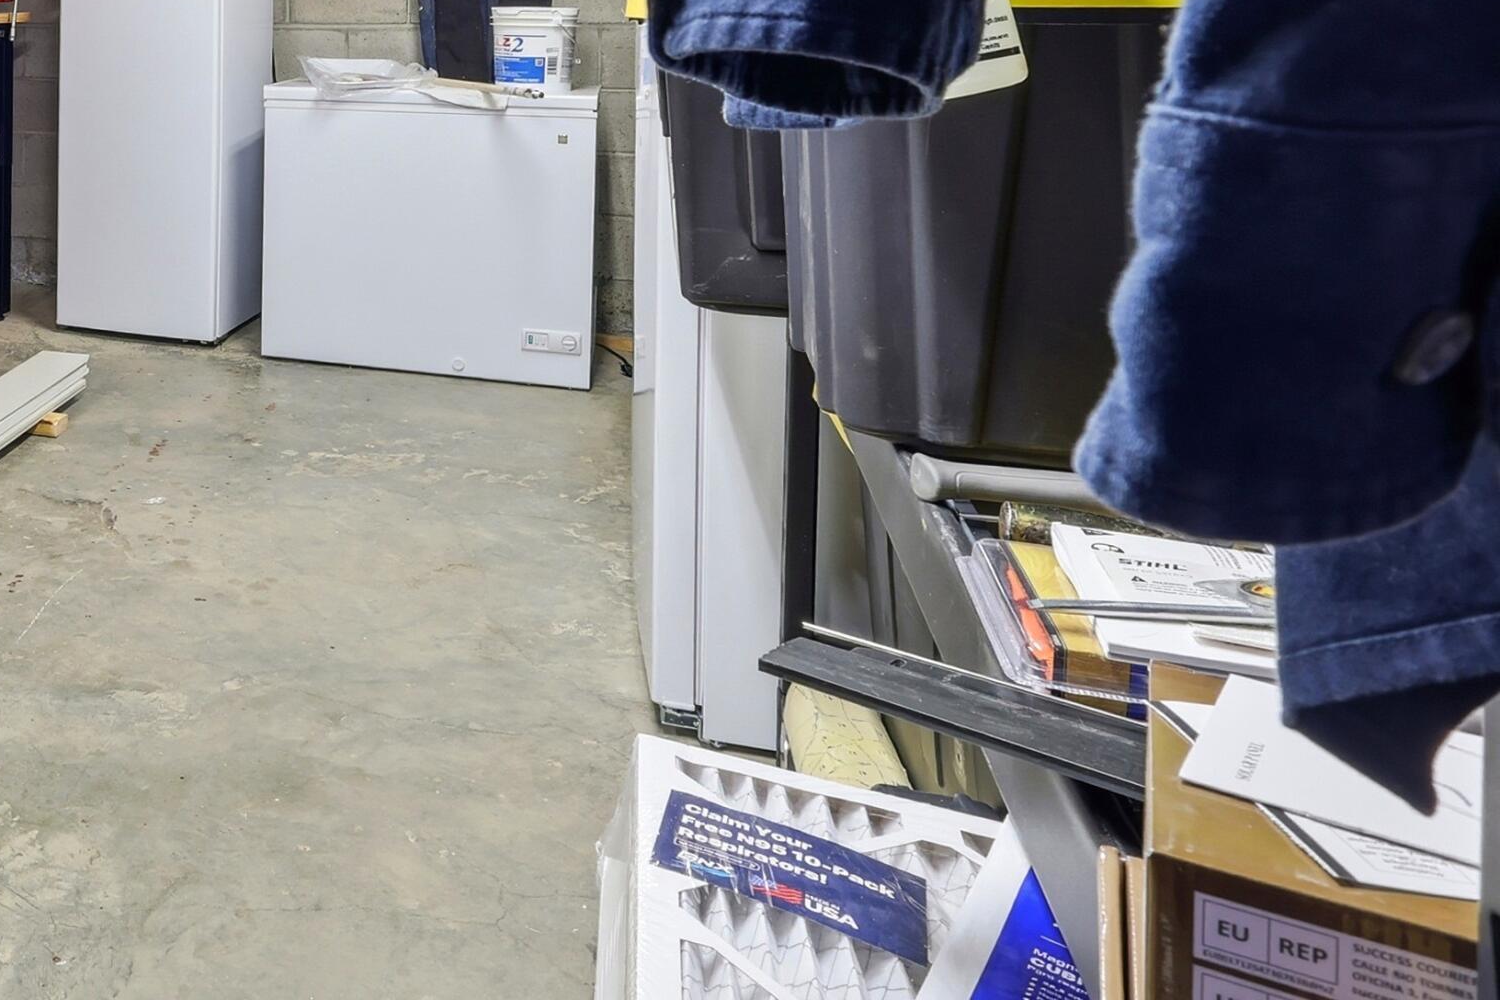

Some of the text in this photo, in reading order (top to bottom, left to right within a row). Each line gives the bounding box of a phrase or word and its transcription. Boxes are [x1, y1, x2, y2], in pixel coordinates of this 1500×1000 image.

[1118, 558, 1188, 571] STIHL
[684, 803, 812, 850] Claim Your
[678, 825, 827, 885] Respirators!
[681, 814, 733, 838] Free
[736, 831, 788, 856] N95
[791, 850, 896, 899] 10-Pack
[804, 897, 859, 930] USA
[1217, 919, 1328, 964] EU REP
[1352, 943, 1413, 968] SUCCESS
[1033, 948, 1077, 972] Magn
[1351, 971, 1404, 994] OFICINA
